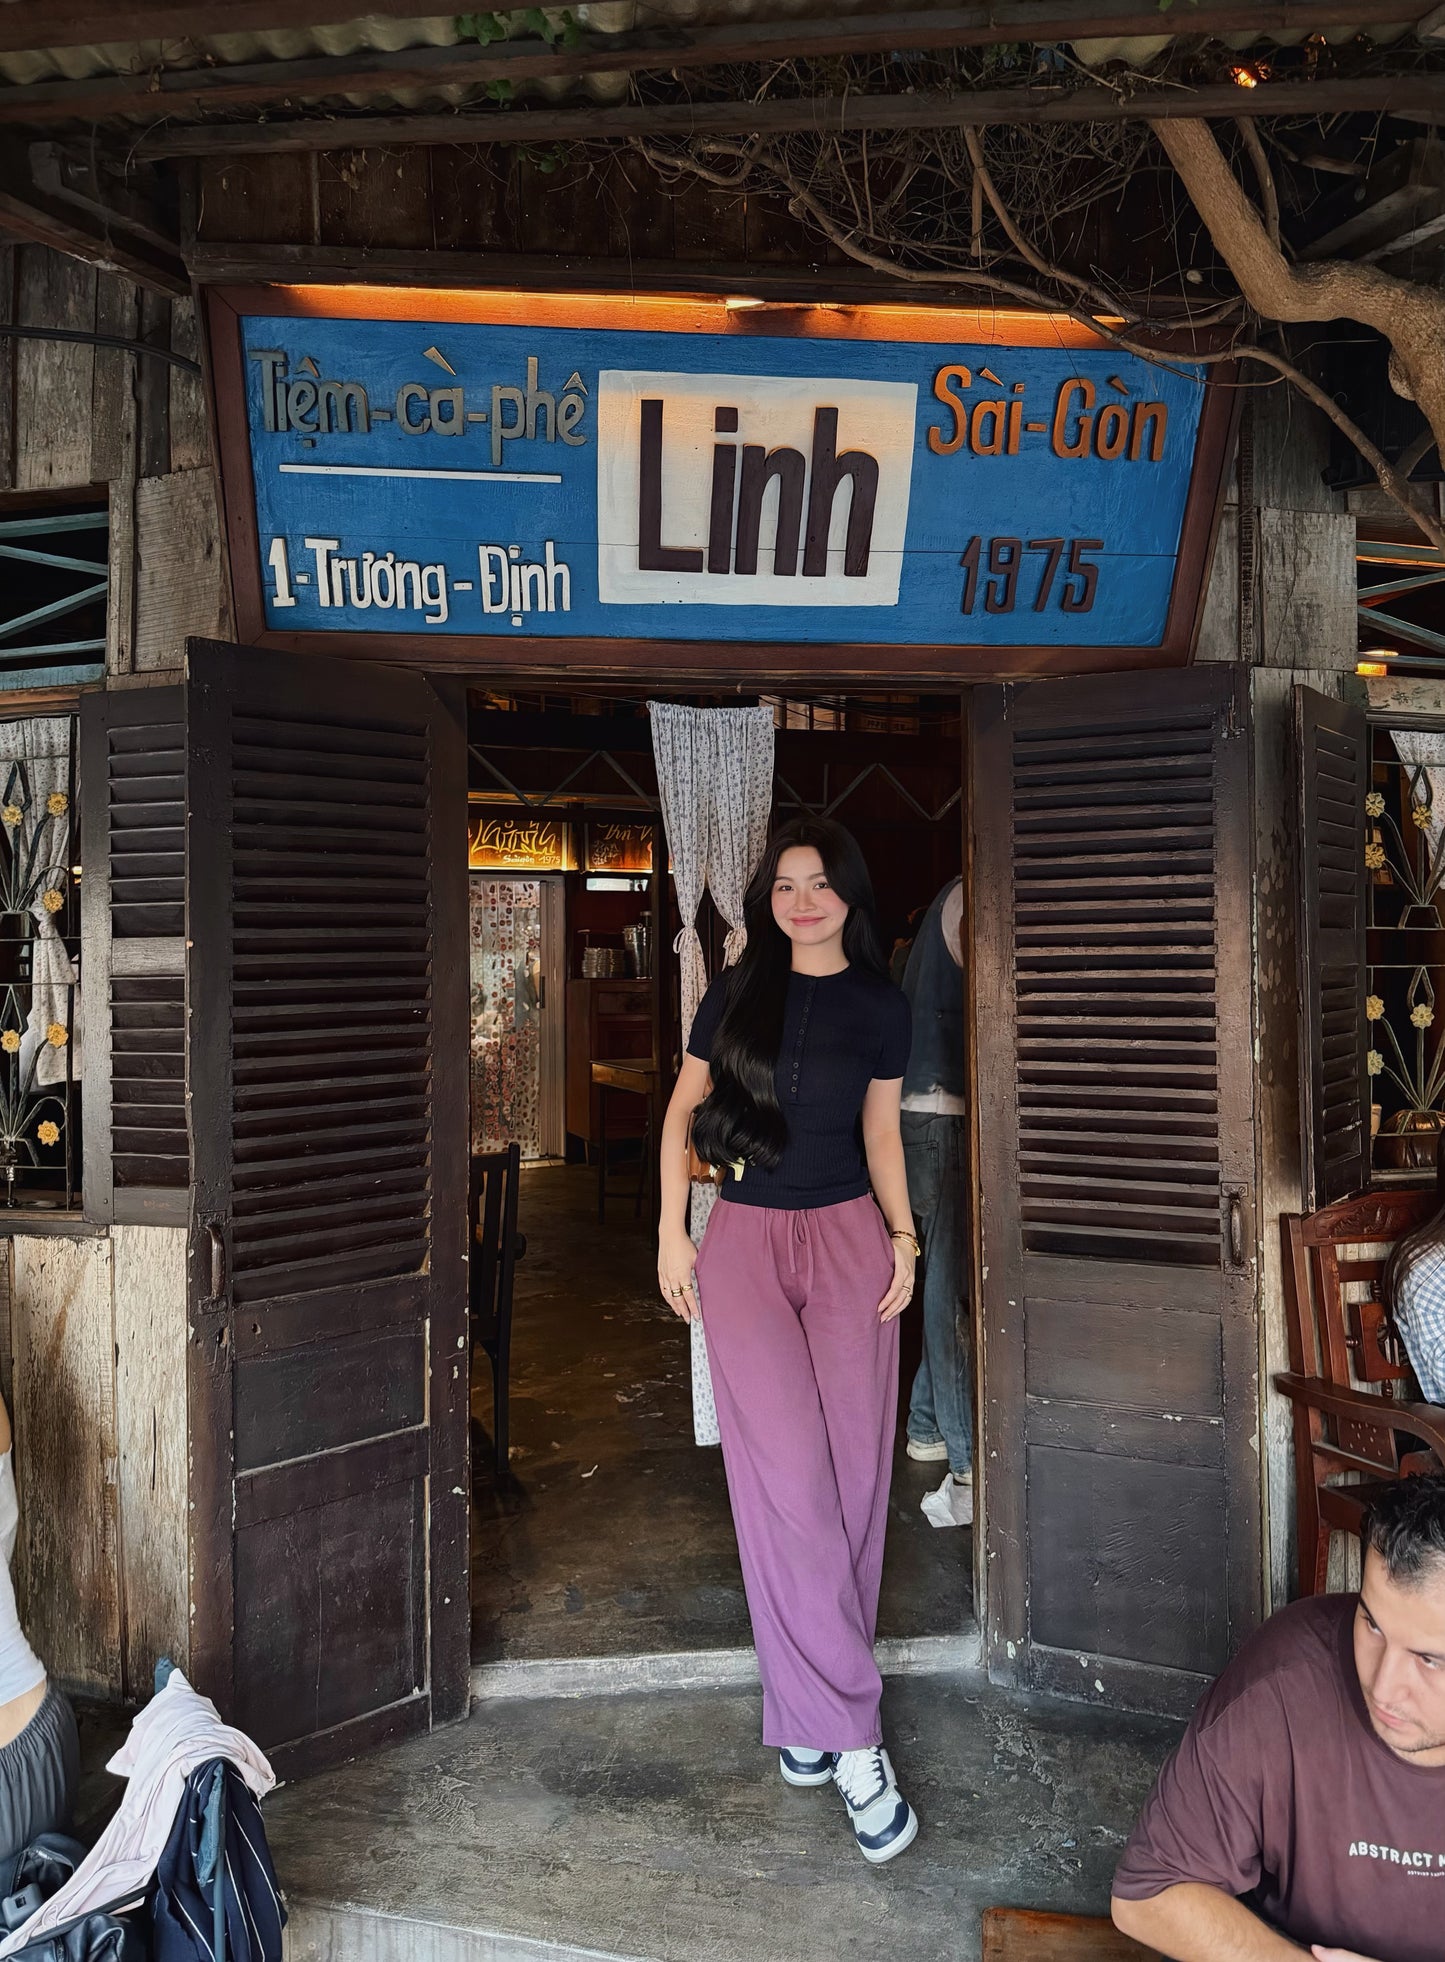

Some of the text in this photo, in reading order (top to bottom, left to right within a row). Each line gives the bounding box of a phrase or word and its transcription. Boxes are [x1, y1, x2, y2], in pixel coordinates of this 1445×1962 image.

[250, 346, 588, 467] Tiệm-cà-phê
[928, 364, 1169, 463] Sài-Gòn
[638, 399, 880, 577] Linh
[960, 535, 1105, 615] 1975
[1348, 1841, 1433, 1868] ABSTRACT
